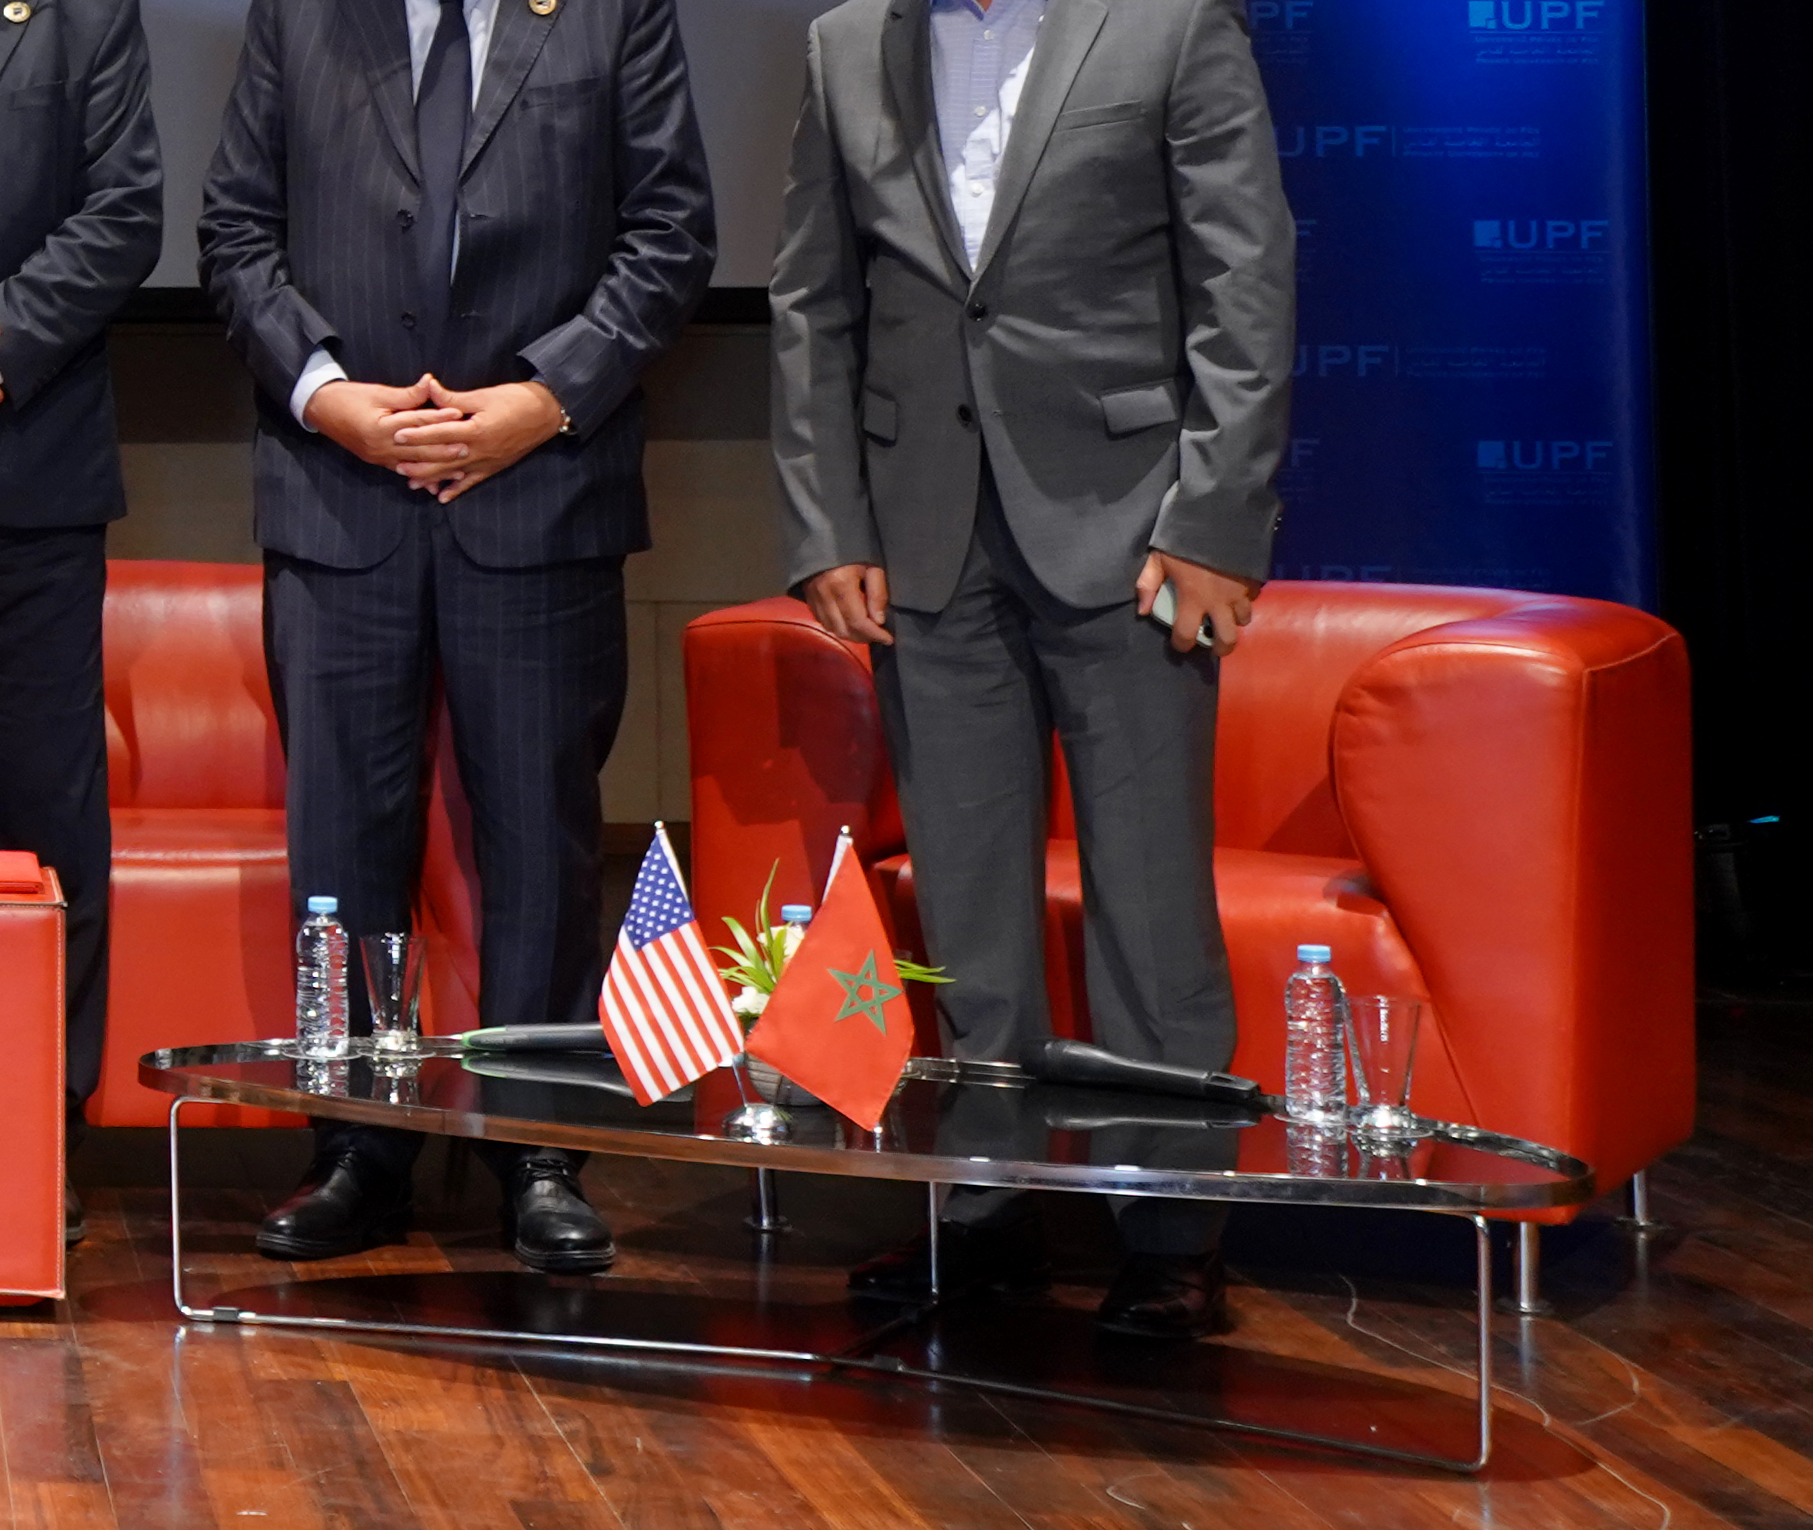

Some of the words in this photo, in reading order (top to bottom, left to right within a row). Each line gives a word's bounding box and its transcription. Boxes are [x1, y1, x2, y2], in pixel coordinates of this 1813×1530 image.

[1250, 0, 1314, 29] PF
[1501, 0, 1604, 29] UPF
[1508, 220, 1608, 249] UPF
[1513, 441, 1613, 469] UPF
